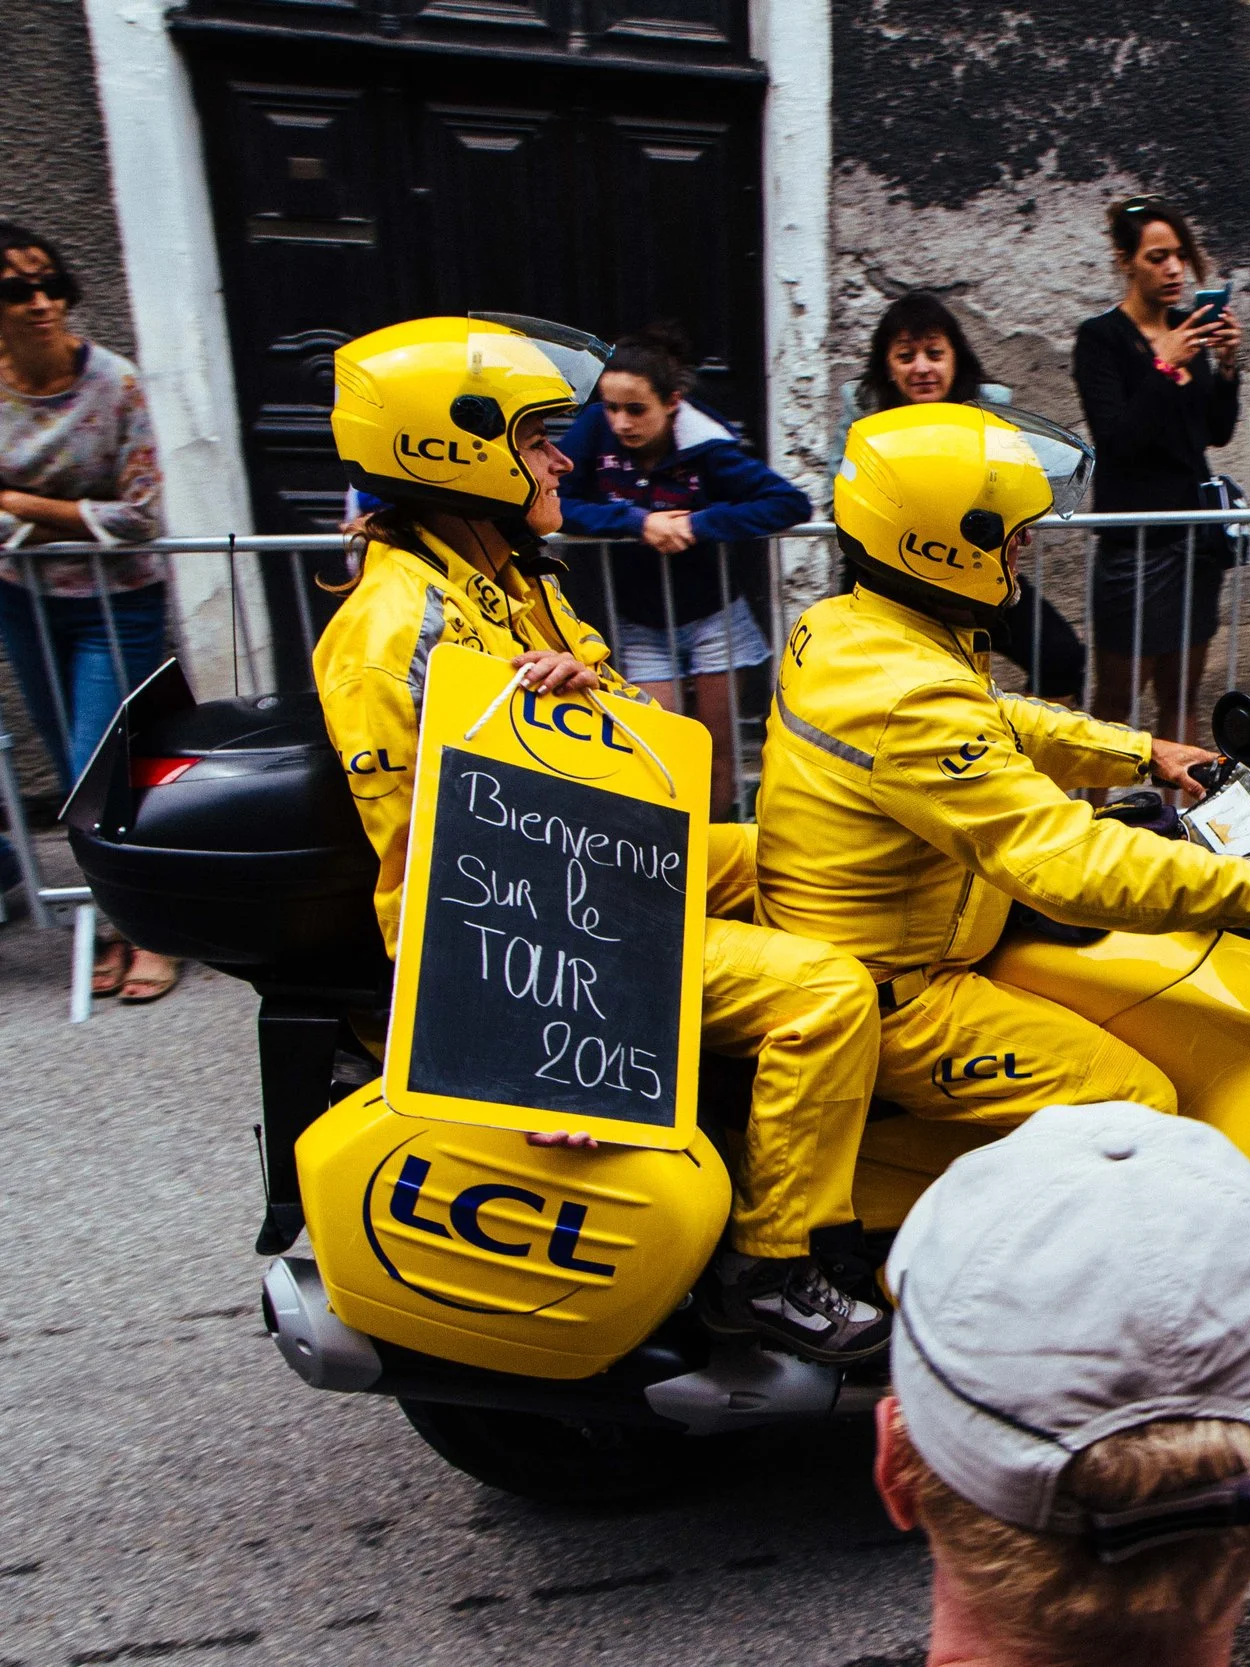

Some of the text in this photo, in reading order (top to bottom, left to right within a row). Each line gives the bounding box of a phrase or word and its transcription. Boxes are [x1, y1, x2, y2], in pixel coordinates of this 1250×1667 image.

[401, 433, 471, 465] LCL
[906, 532, 965, 570] LCL
[474, 575, 501, 615] LCL
[523, 691, 633, 754] LCL
[460, 771, 687, 894] Bienvenue
[566, 858, 621, 941] le
[534, 1021, 662, 1100] 2015
[941, 1053, 1033, 1082] LCL
[389, 1154, 616, 1277] LCL
